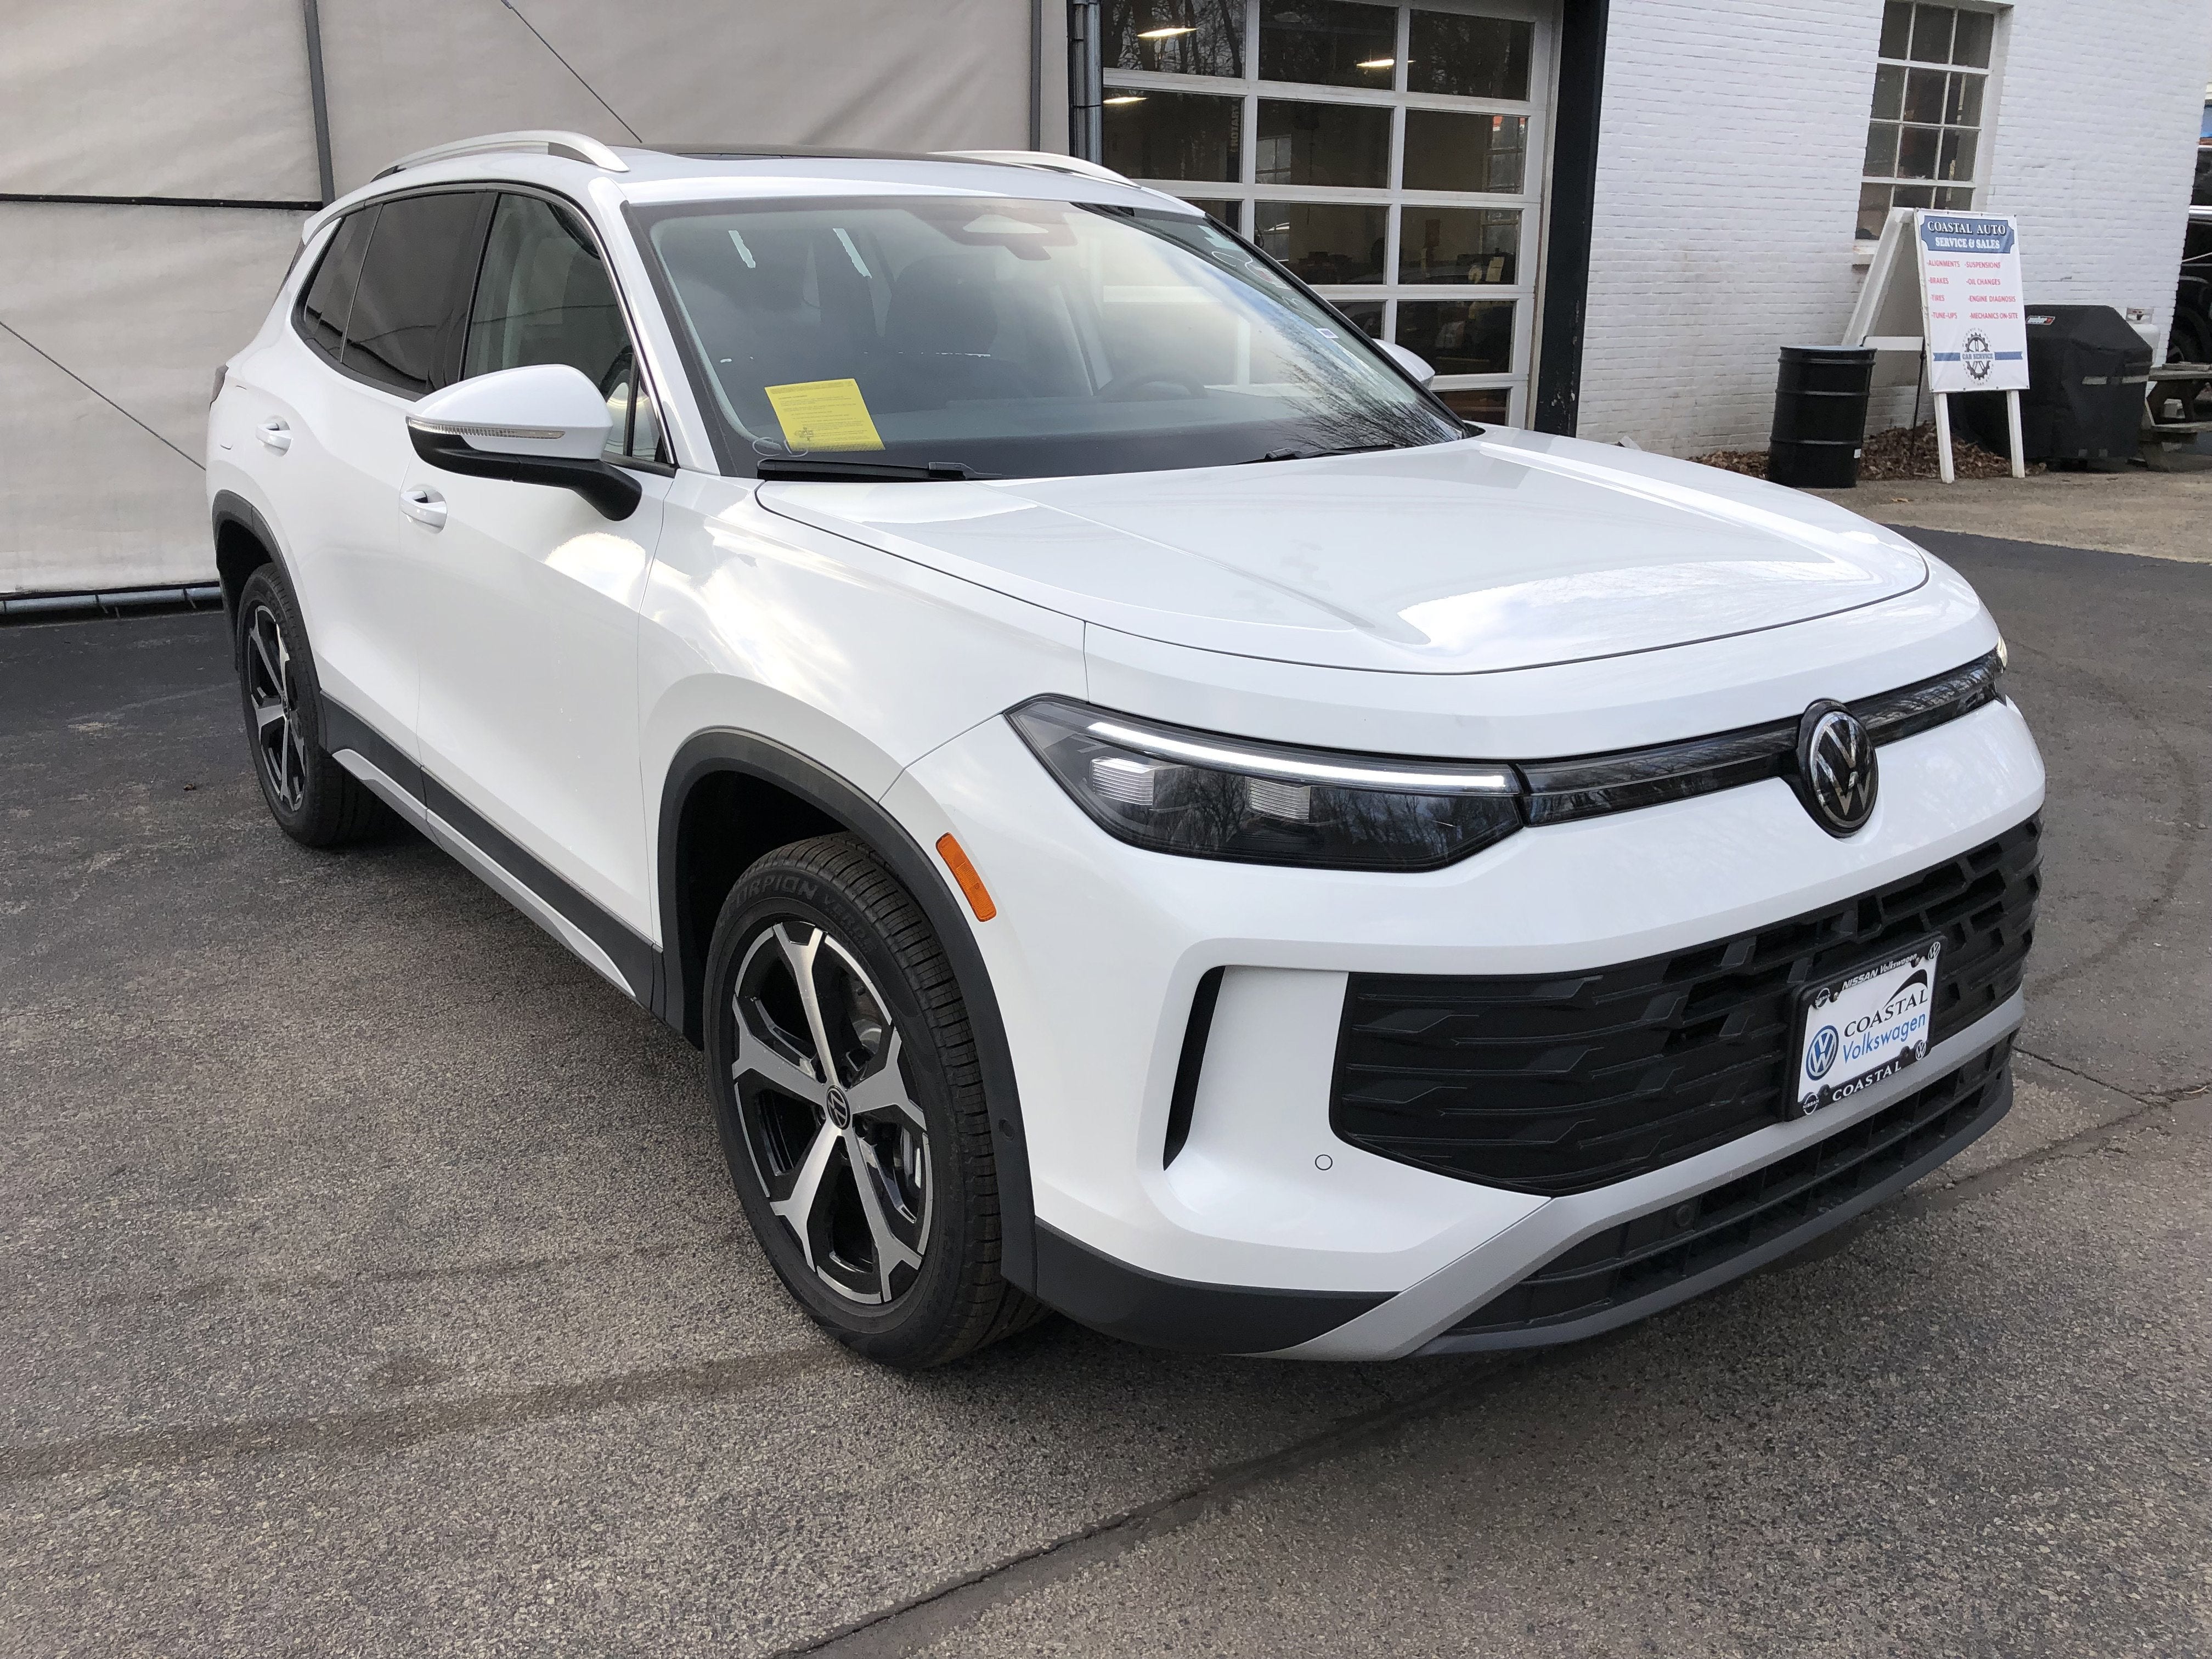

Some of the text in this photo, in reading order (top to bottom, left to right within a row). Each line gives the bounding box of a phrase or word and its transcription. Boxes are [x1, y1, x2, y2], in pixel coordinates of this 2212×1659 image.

[1927, 221, 2006, 235] COASTAL AUTO
[1935, 236, 2000, 249] SERVICE & SALES
[1842, 953, 1918, 990] NISSAN Volkswagen
[1844, 989, 1928, 1038] COASTAL
[1843, 1013, 1926, 1064] Volkswagen
[1832, 1061, 1901, 1102] COASTAL
